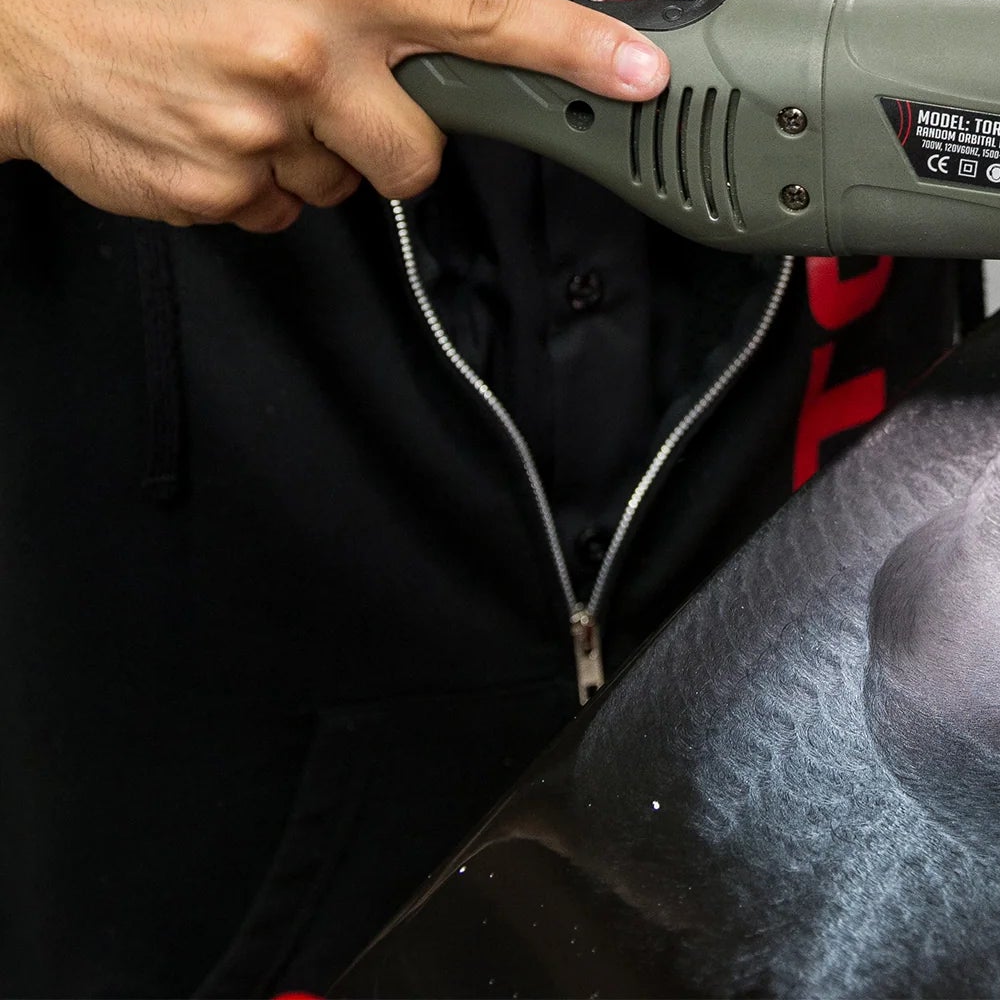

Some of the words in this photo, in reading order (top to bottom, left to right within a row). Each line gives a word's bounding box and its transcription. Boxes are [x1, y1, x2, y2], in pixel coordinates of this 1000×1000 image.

[917, 109, 970, 132] MODEL:
[916, 126, 956, 141] RANDOM
[958, 132, 996, 148] ORBITAL
[921, 139, 943, 152] 700W,
